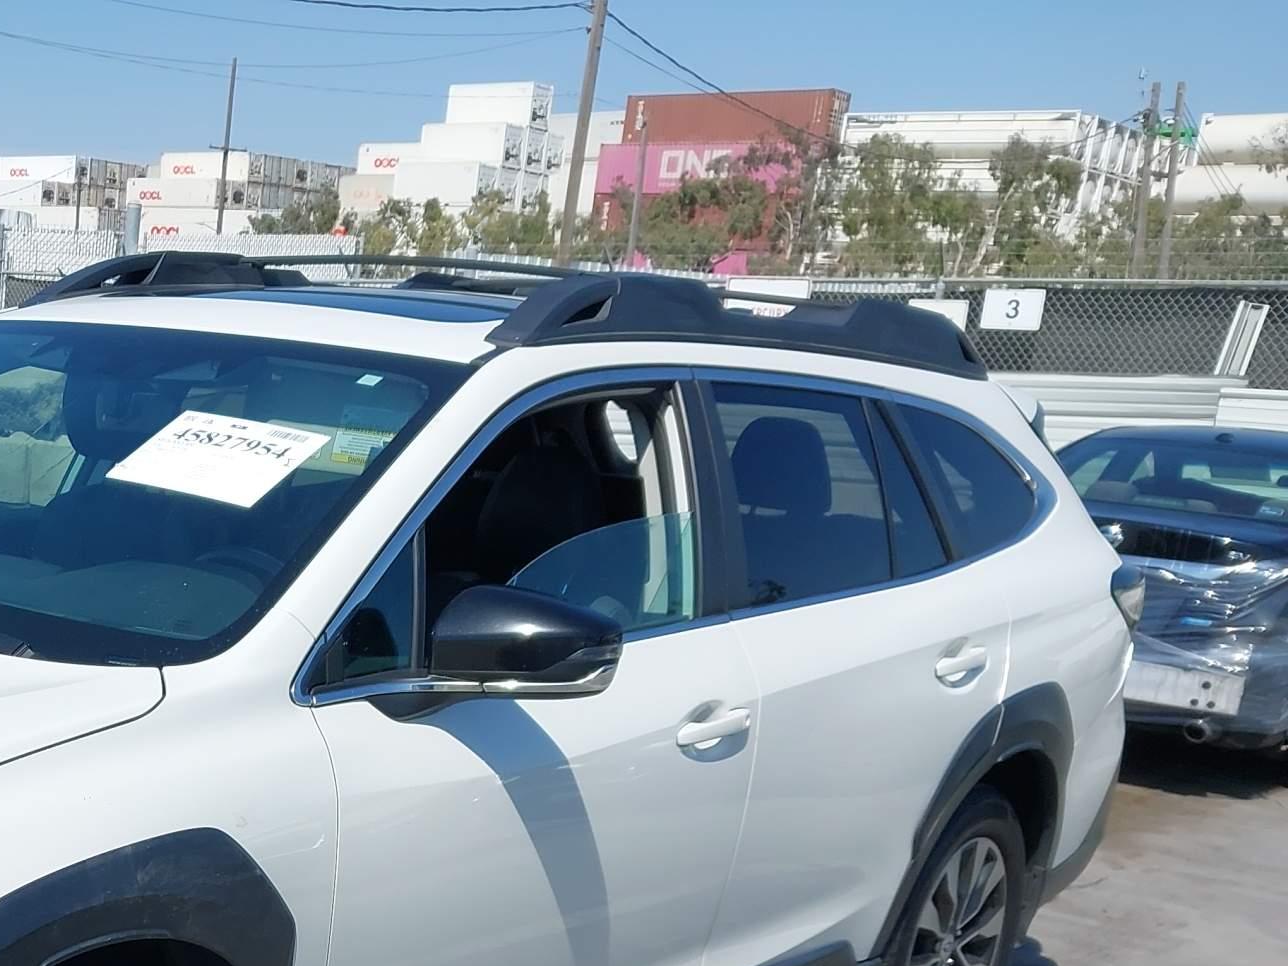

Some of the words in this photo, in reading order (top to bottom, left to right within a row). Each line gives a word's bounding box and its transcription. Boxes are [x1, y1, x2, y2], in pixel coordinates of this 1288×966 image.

[172, 165, 196, 175] OOCL
[139, 191, 162, 200] OOCL
[1005, 299, 1020, 319] 3
[173, 427, 291, 459] 45827954
